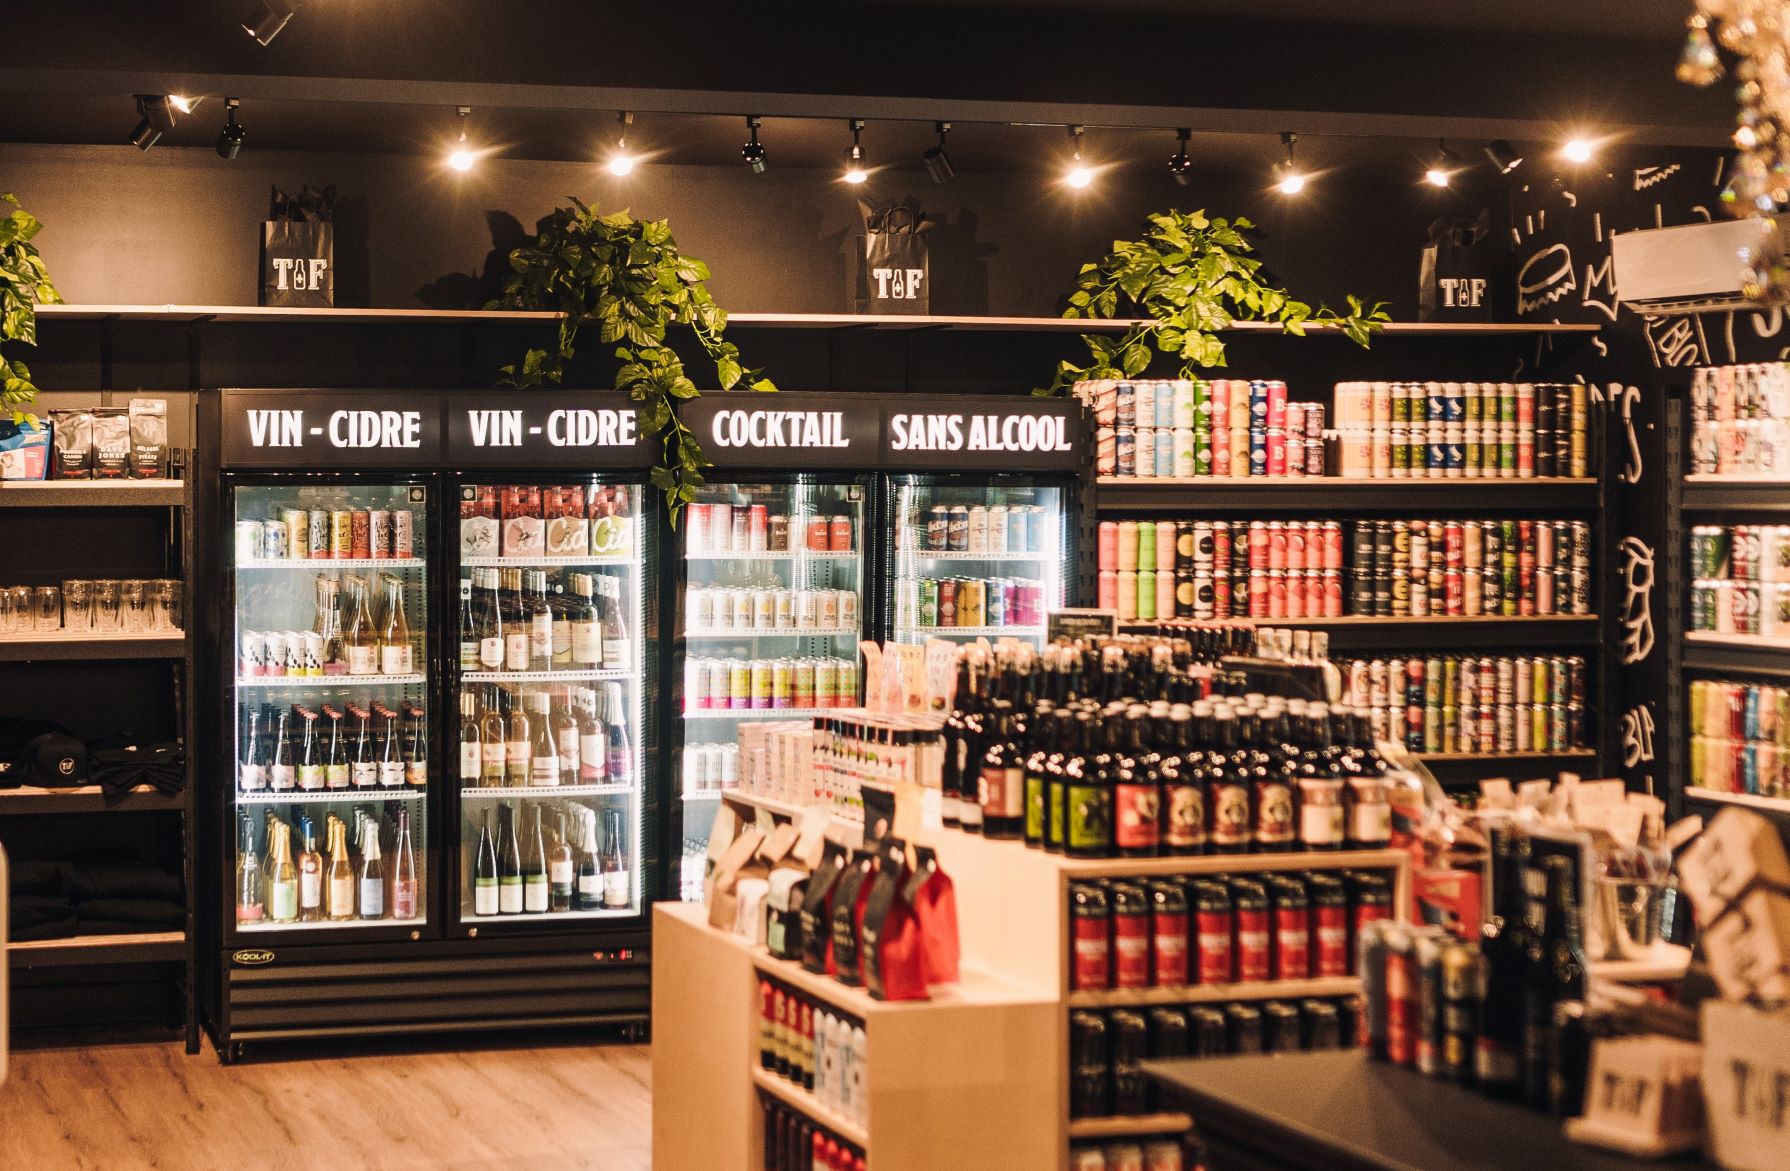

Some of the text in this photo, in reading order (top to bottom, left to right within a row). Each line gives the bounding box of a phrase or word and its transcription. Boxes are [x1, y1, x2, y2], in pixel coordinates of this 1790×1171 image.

[247, 409, 304, 447] VIN
[328, 409, 421, 448] CIDRE
[467, 410, 523, 447] VIN
[547, 409, 637, 447] CIDRE
[712, 410, 850, 447] COCKTAIL
[891, 414, 1072, 451] SANS ALCOOL
